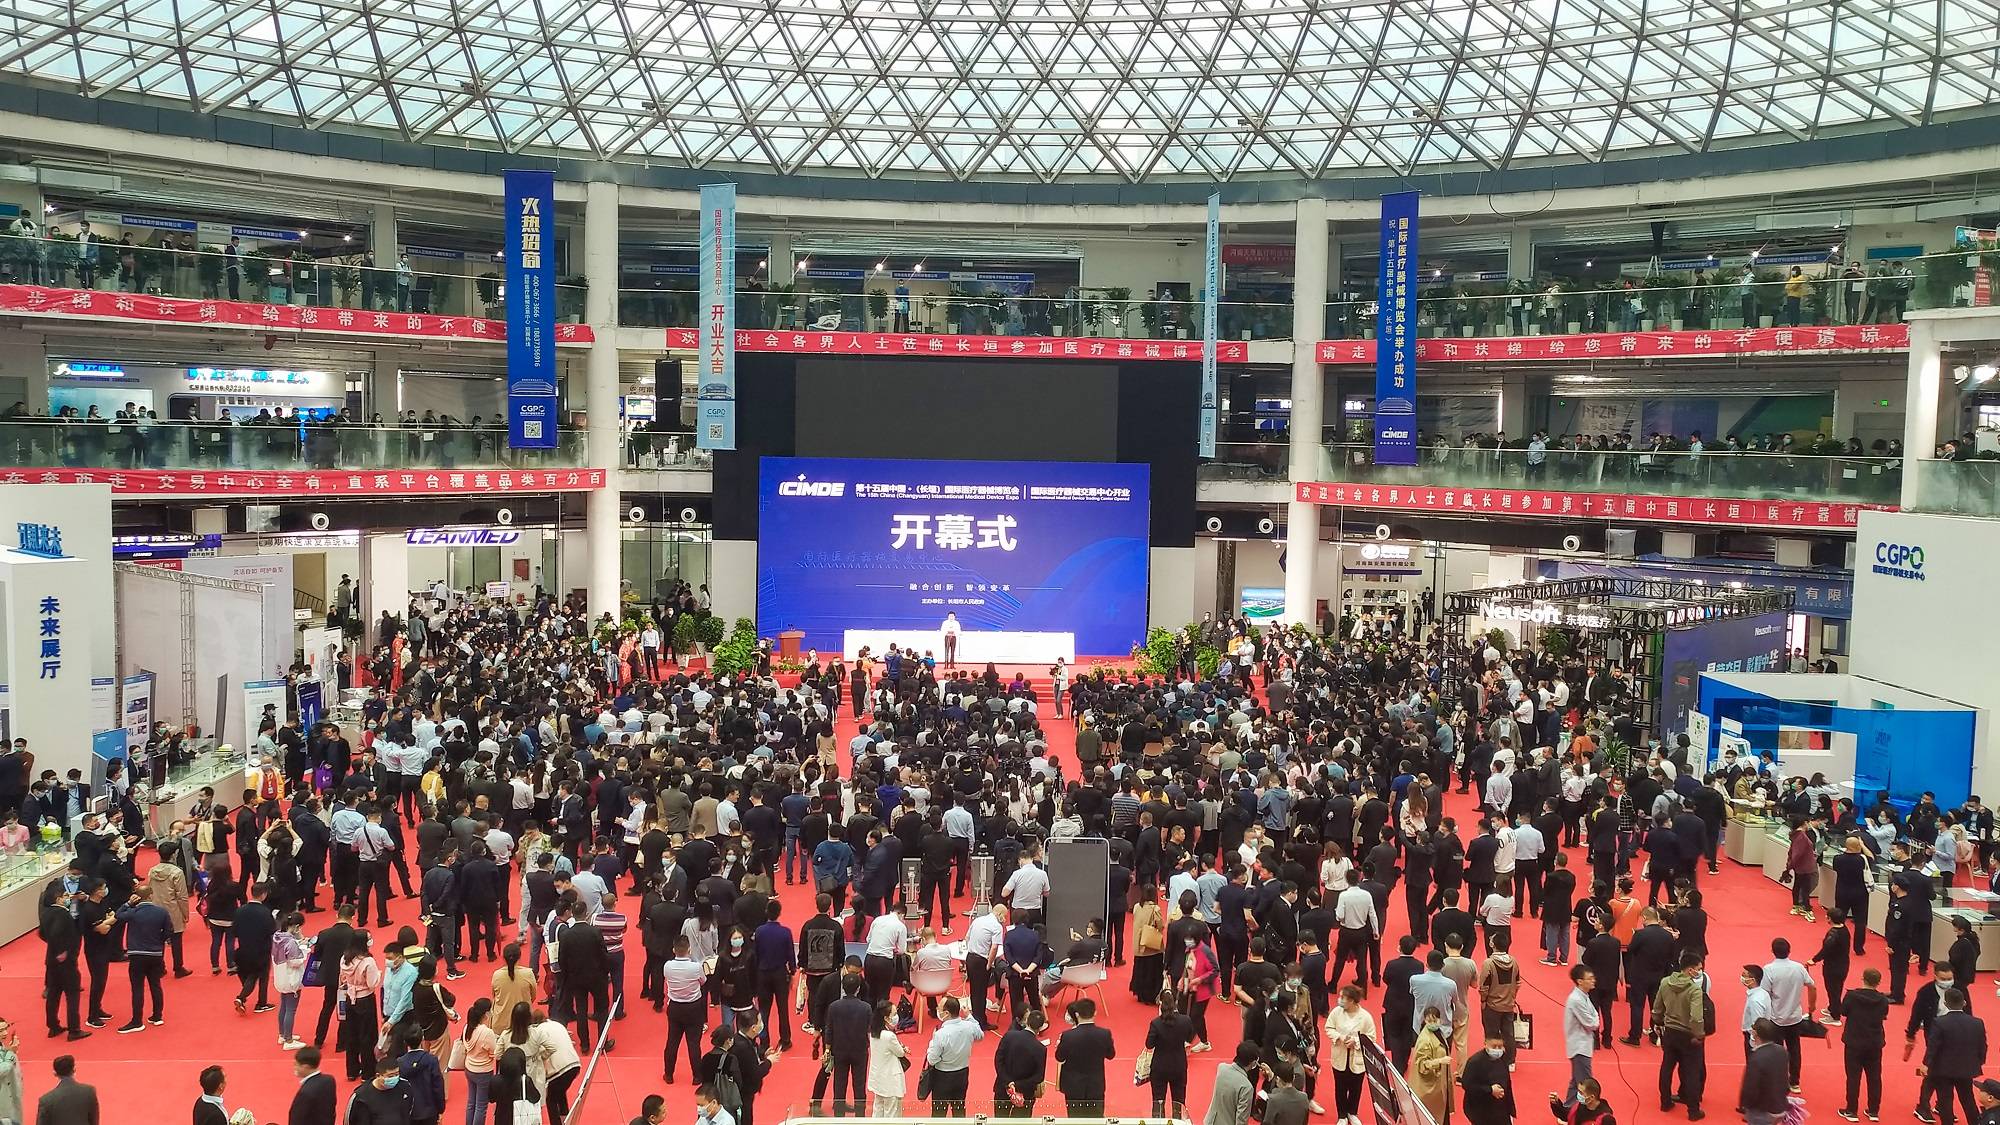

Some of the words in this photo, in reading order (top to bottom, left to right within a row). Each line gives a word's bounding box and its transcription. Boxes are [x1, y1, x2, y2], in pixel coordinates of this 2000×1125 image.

[521, 198, 541, 269] 火热招商
[1394, 217, 1409, 388] 国际医疗器械博览会举办成功
[680, 331, 1241, 358] 欢社会各界人士莅临长垣参加医疗器械博会
[711, 304, 724, 375] 开业大吉
[407, 528, 520, 544] LEANMED
[890, 514, 1018, 551] 开幕式
[1876, 542, 1924, 569] CGPO
[1480, 600, 1563, 626] Neusoft
[1566, 614, 1612, 629] 东软医疗
[40, 596, 61, 679] 未来展厅
